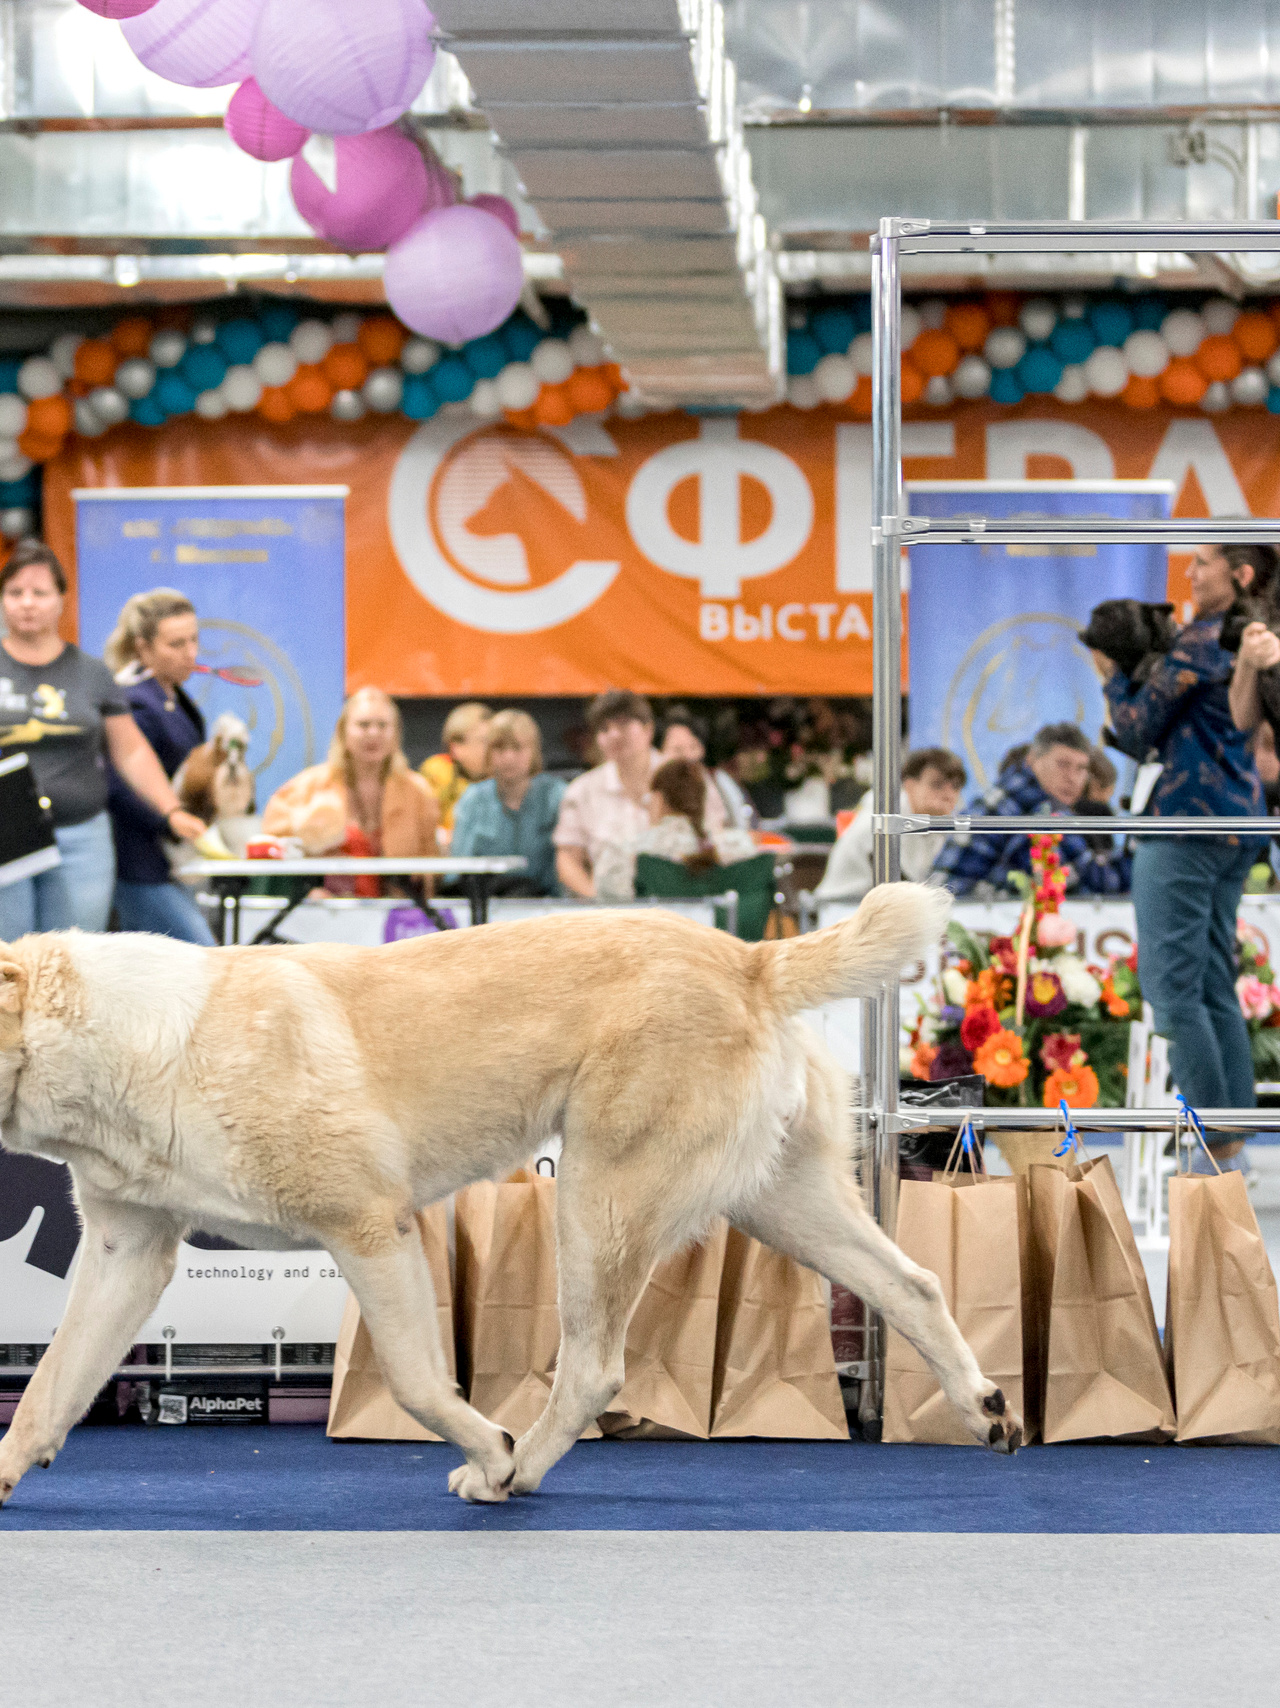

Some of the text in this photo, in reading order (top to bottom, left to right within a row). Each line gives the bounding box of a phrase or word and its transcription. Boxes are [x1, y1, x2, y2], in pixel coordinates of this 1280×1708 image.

[187, 1266, 274, 1280] technology
[284, 1266, 309, 1278] and
[189, 1396, 263, 1413] AlphaPet
